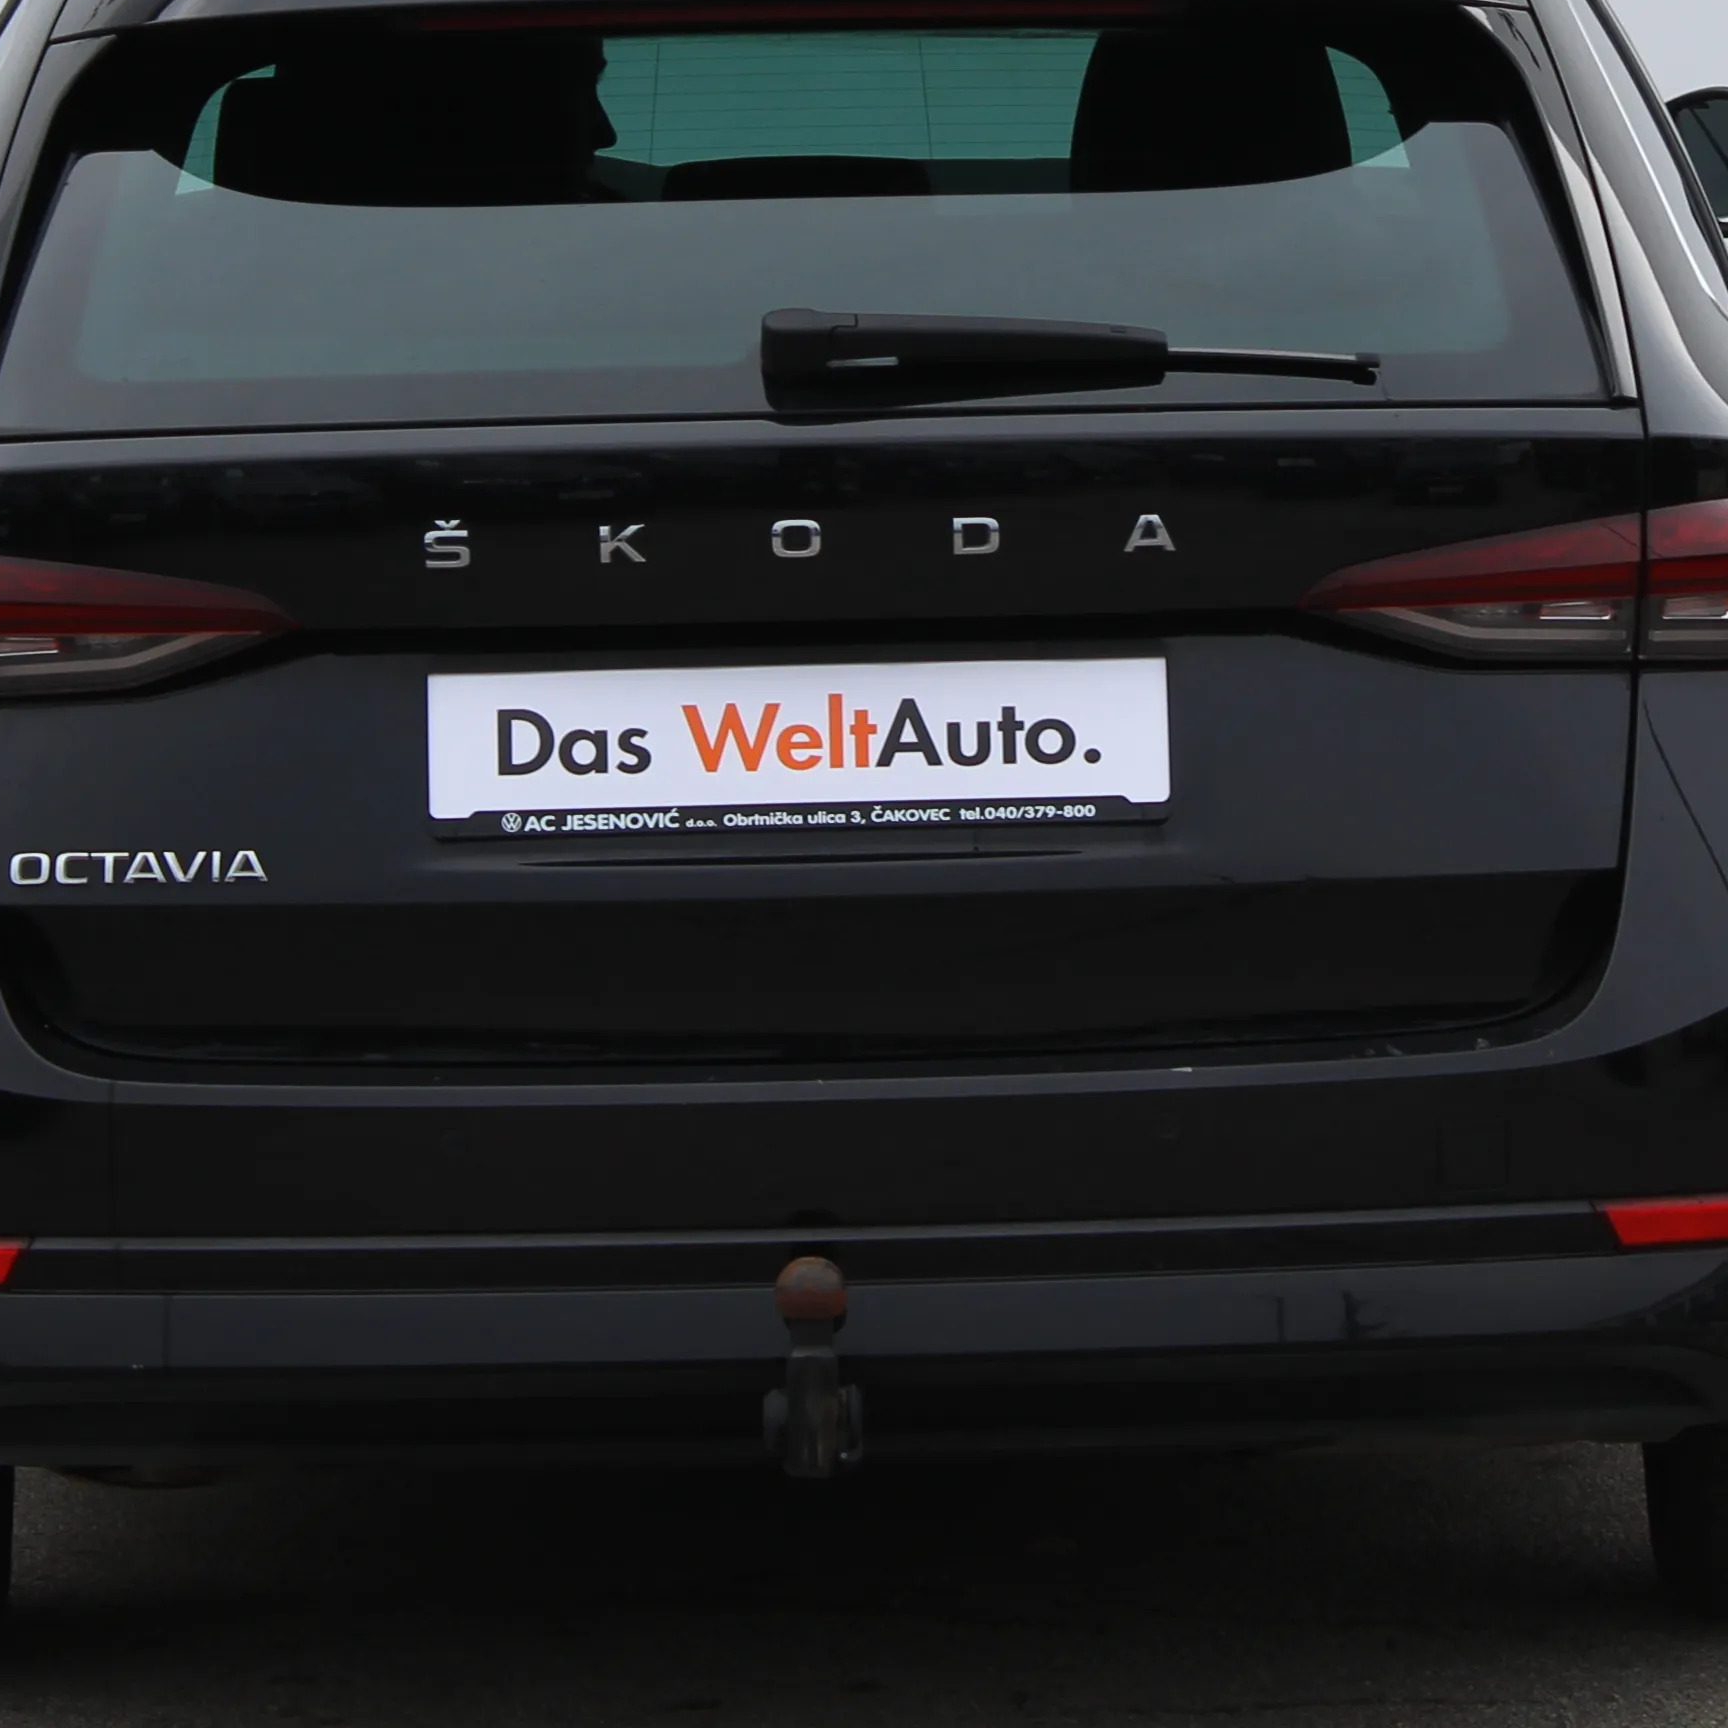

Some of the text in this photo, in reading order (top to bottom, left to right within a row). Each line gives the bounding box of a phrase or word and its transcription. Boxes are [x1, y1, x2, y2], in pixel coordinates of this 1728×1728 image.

[423, 513, 1176, 568] ŠKODA
[497, 693, 1102, 776] Das WeltAuto.
[524, 815, 556, 832] AC
[560, 808, 680, 831] JESENOVIĆ
[685, 818, 718, 828] d.o.o.
[722, 811, 804, 827] Obrtnička
[807, 810, 847, 825] ulica
[850, 810, 867, 825] 3,
[870, 805, 951, 823] ČAKOVEC
[10, 849, 269, 885] OCTAVIA
